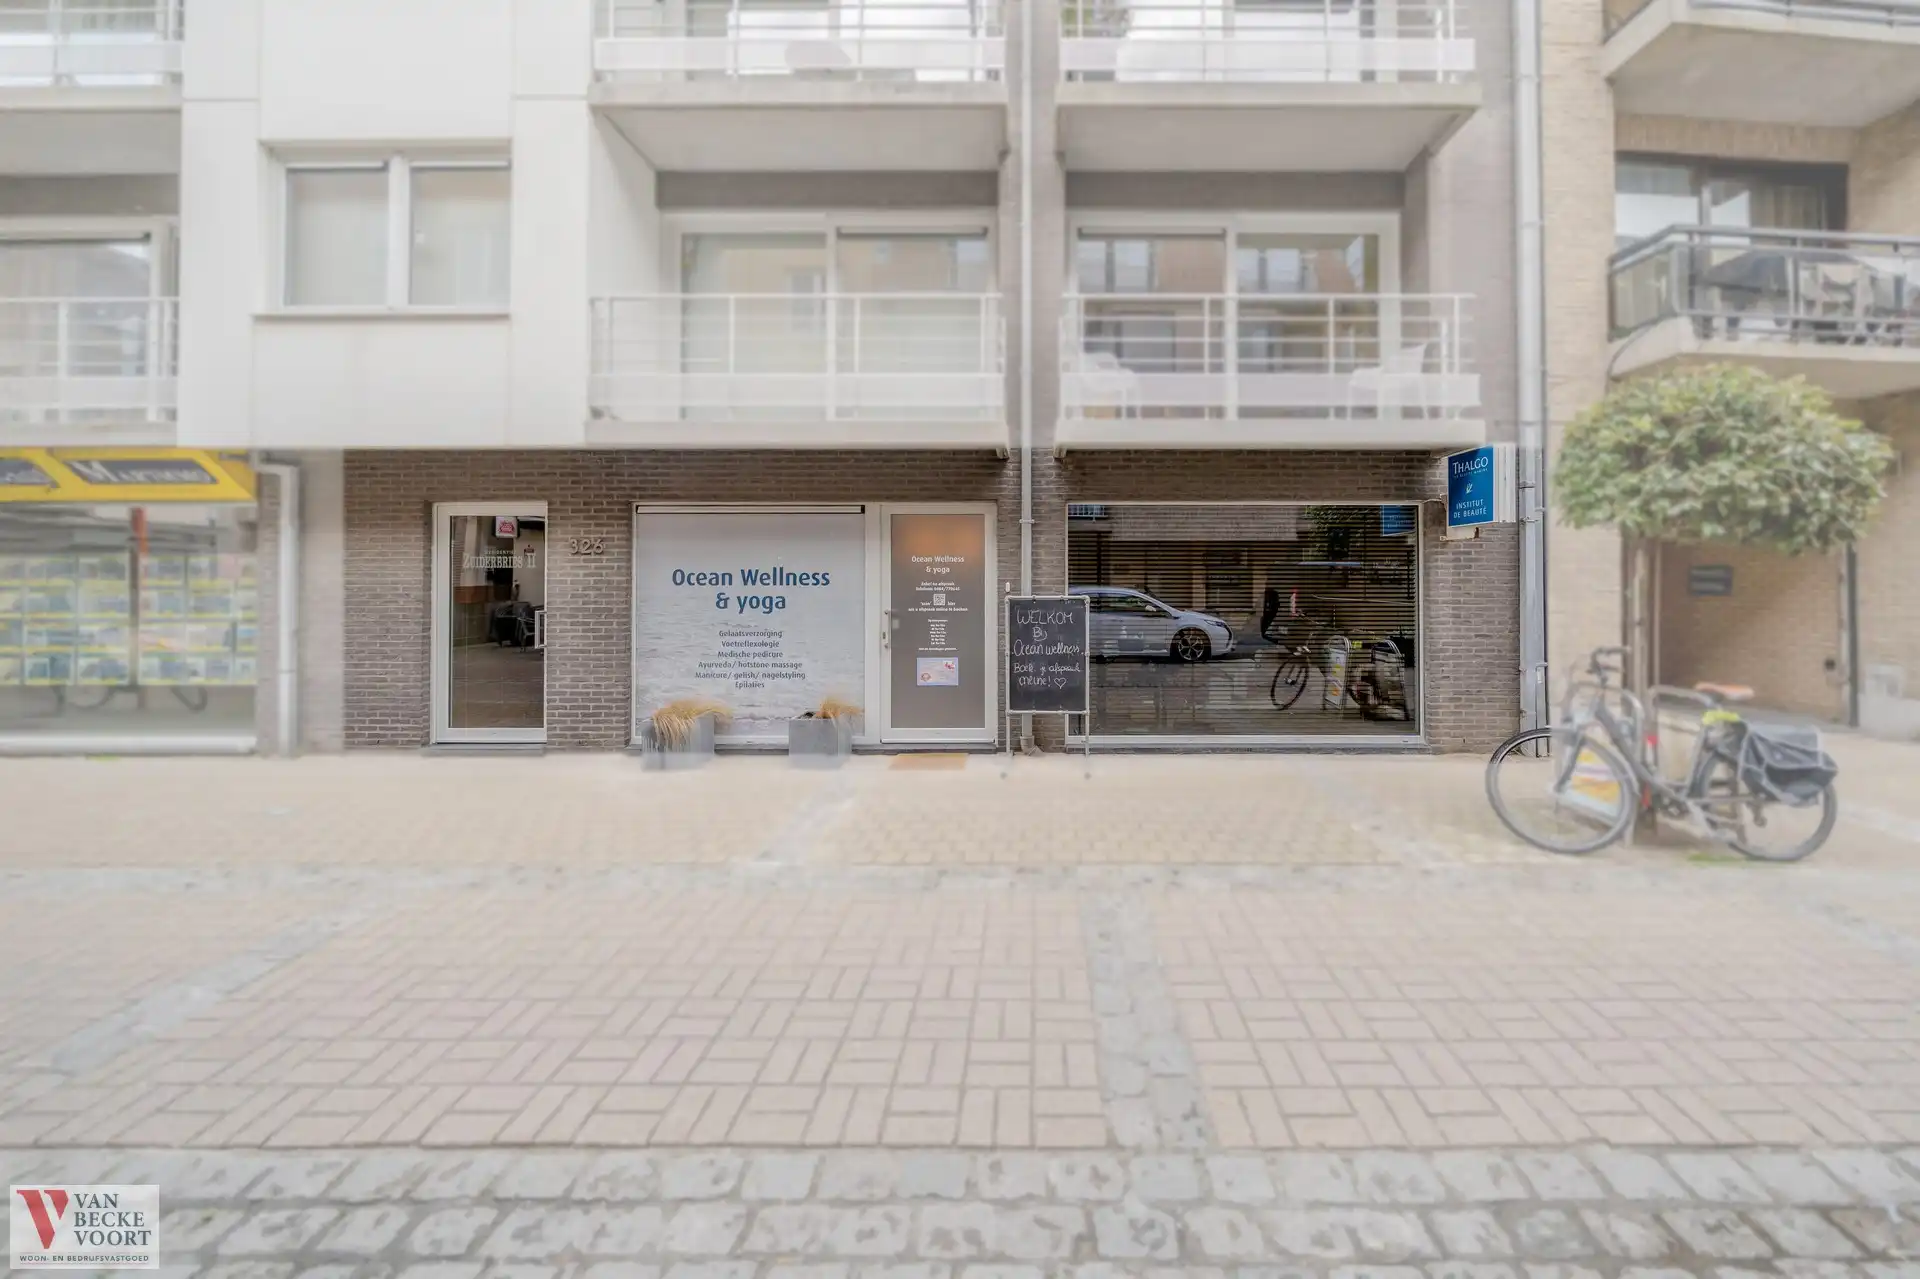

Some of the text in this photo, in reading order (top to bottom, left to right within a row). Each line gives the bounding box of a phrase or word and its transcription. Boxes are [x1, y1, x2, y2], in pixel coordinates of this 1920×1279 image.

[1453, 457, 1488, 474] THALGO
[1456, 499, 1483, 509] INSTITUT
[569, 538, 604, 555] 326
[911, 555, 965, 563] Ocean Wellness
[932, 567, 950, 575] yoga
[672, 566, 831, 587] Ocean Wellness
[715, 592, 787, 614] & yoga
[1016, 609, 1074, 625] WELKOM
[719, 630, 783, 639] Gelaatsverzorging
[721, 640, 780, 648] Voetreflexologie
[1013, 639, 1080, 656] Ocean wellness
[718, 650, 783, 659] Medische pedicure
[698, 661, 736, 669] Ayurveda/
[738, 660, 770, 668] hotstone
[695, 671, 732, 679] Manicure/
[762, 671, 806, 680] nagelstyling
[735, 681, 765, 690] Epilaties
